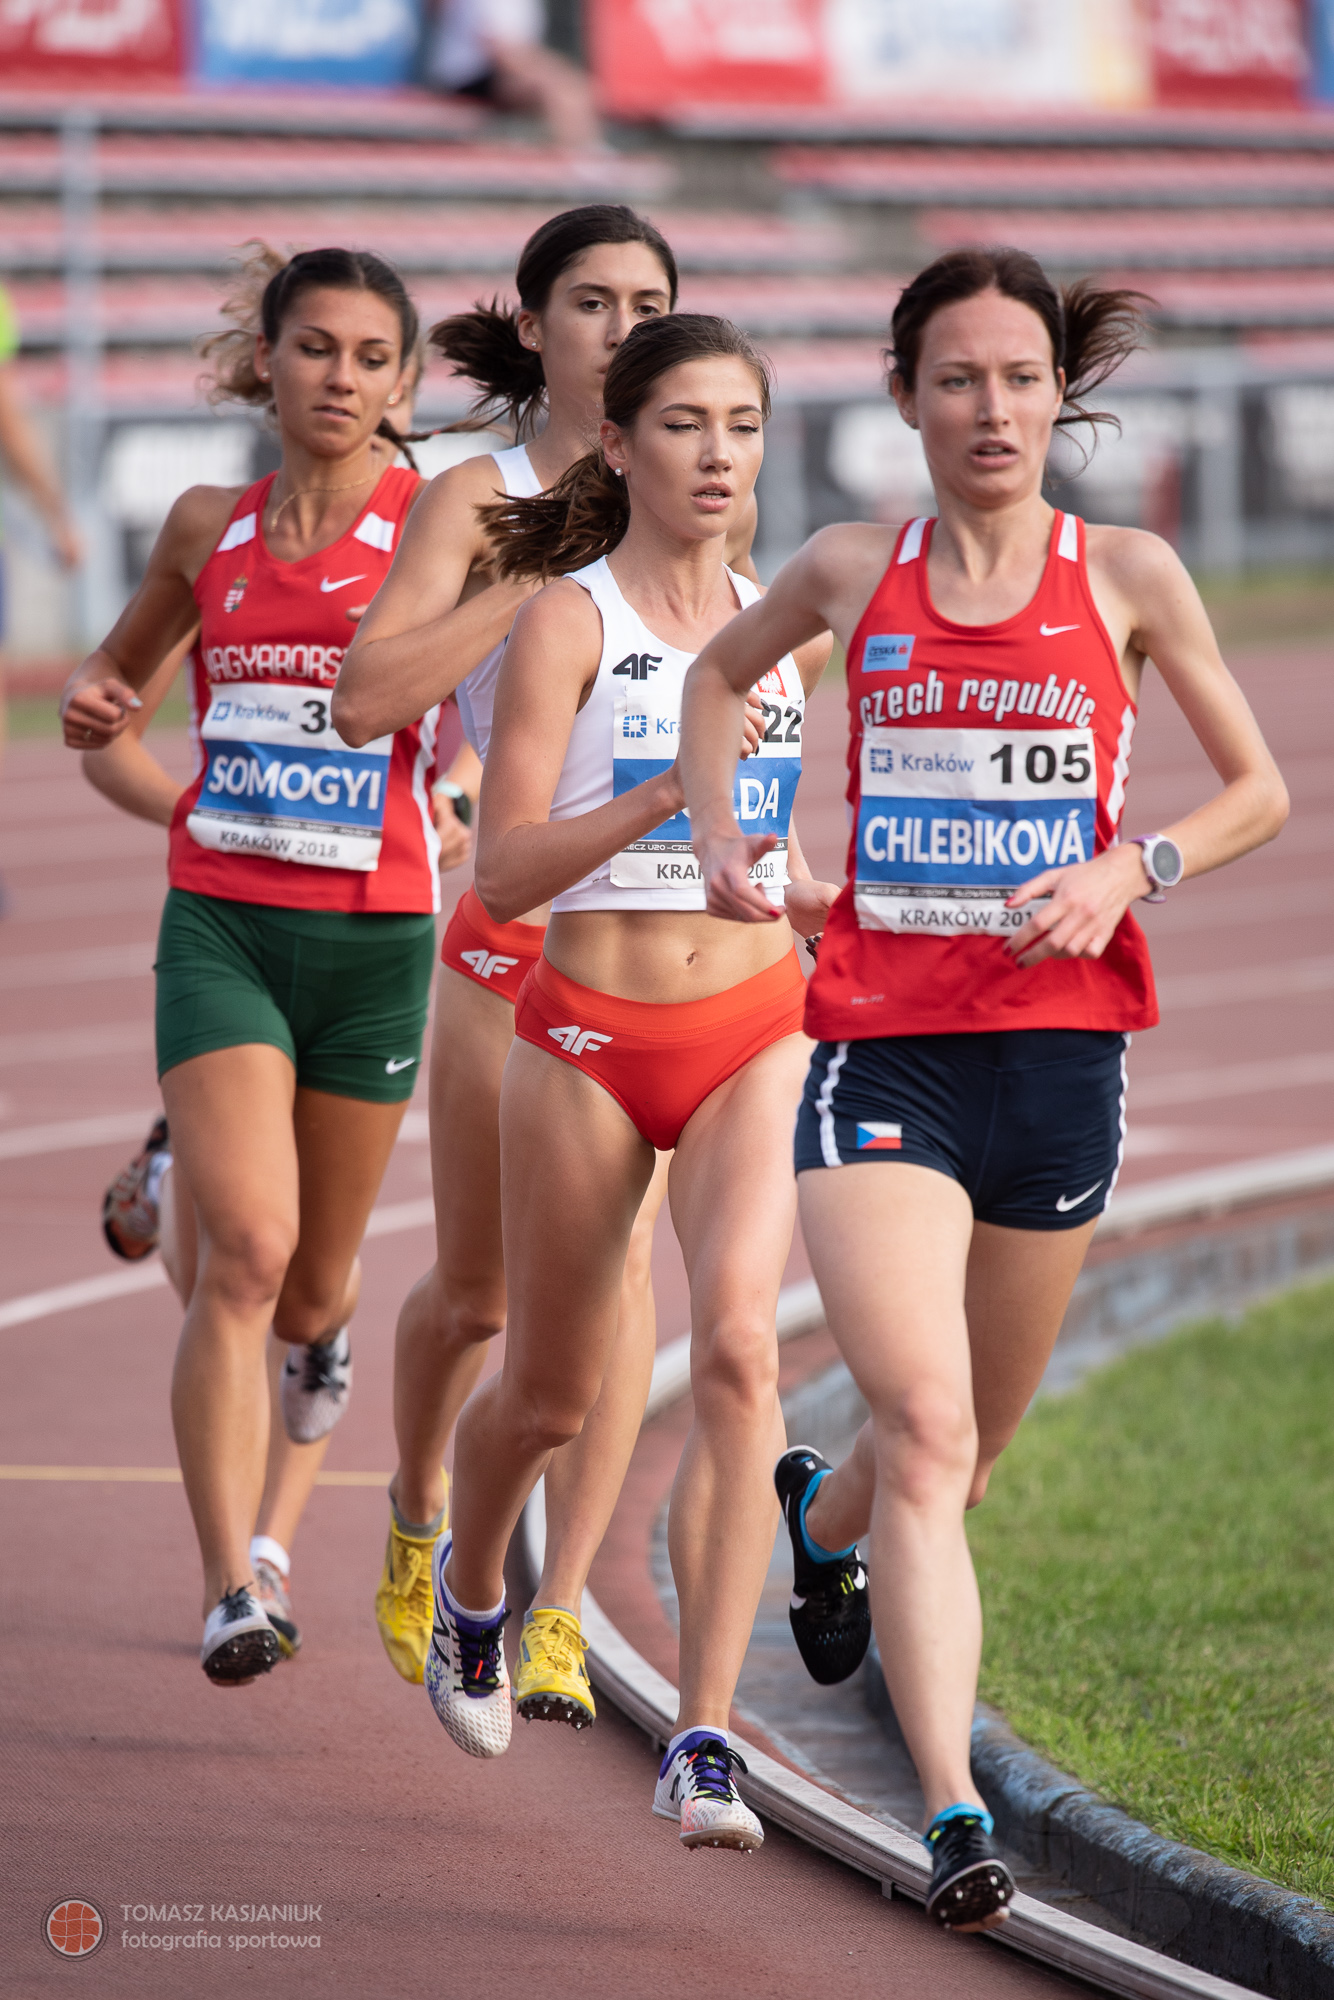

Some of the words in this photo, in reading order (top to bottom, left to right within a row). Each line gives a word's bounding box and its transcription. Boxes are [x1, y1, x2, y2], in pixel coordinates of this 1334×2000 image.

[612, 653, 663, 680] 4F
[234, 702, 290, 722] Kraków
[958, 673, 1096, 729] republic
[901, 753, 974, 774] Kraków
[990, 742, 1092, 784] 105
[207, 754, 382, 811] SOMOGYI
[219, 831, 292, 853] KRAKÓW
[297, 841, 339, 859] 2018
[863, 808, 1087, 867] CHLEBIKOVÁ
[747, 862, 775, 879] 2018
[900, 906, 992, 927] KRAKÓW
[460, 949, 519, 979] 4F
[547, 1025, 613, 1056] 4F
